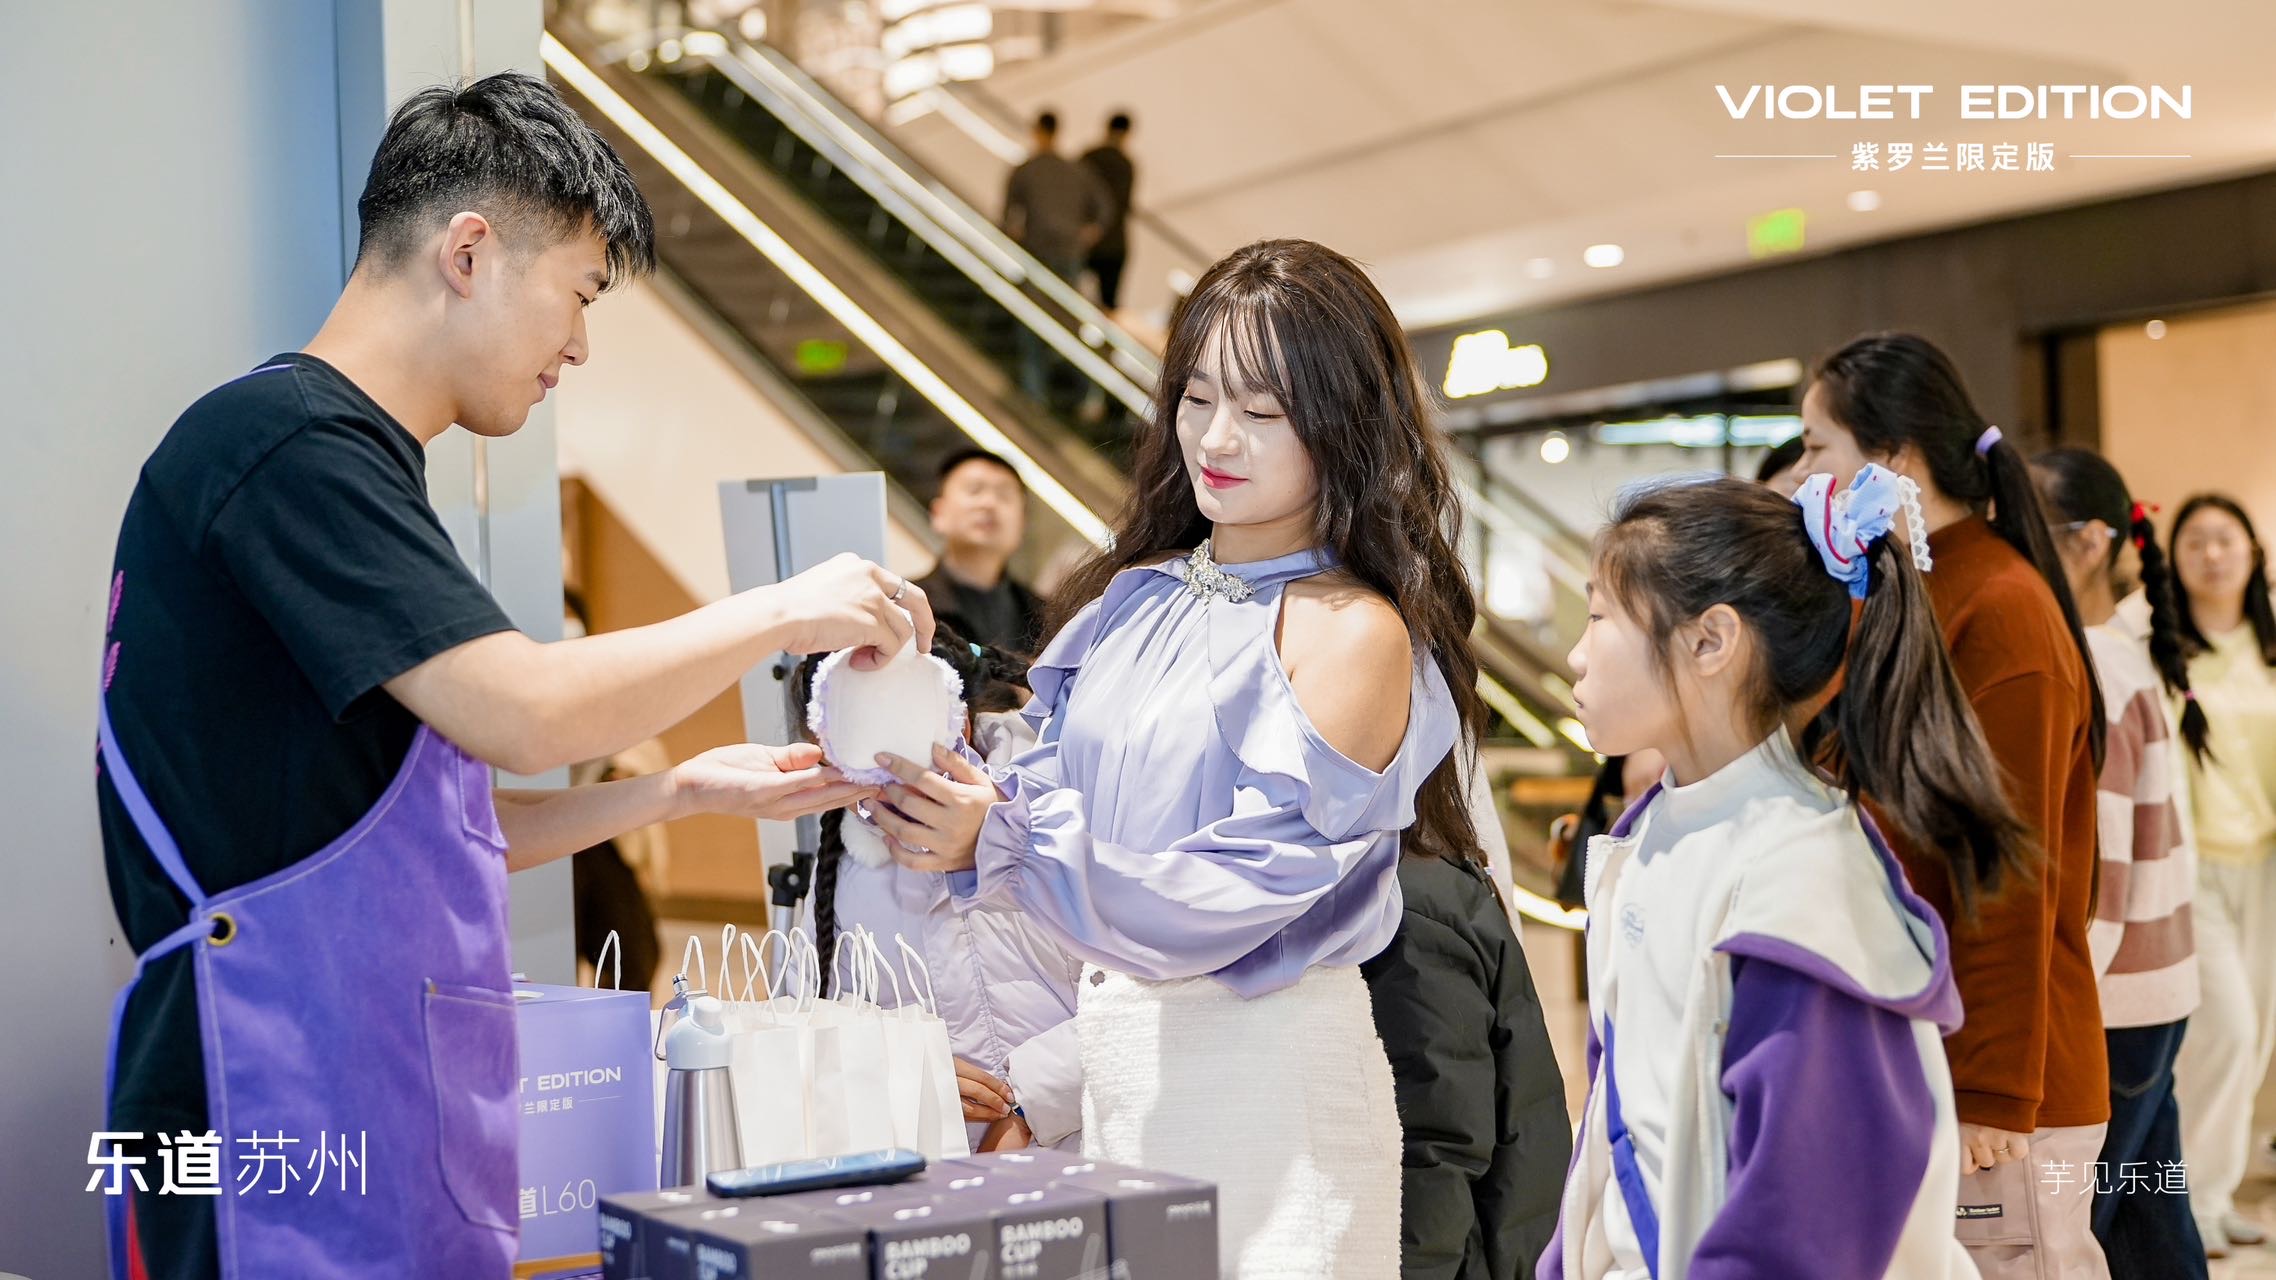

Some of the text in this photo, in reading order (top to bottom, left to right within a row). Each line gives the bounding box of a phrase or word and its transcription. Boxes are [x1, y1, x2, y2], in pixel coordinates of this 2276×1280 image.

[537, 1066, 621, 1091] EDITION
[520, 1096, 573, 1115] 兰限定版
[1001, 1216, 1084, 1244] BAMBOO
[884, 1233, 971, 1261] BAMBOO
[1001, 1240, 1042, 1264] CUP
[884, 1256, 928, 1280] CUP
